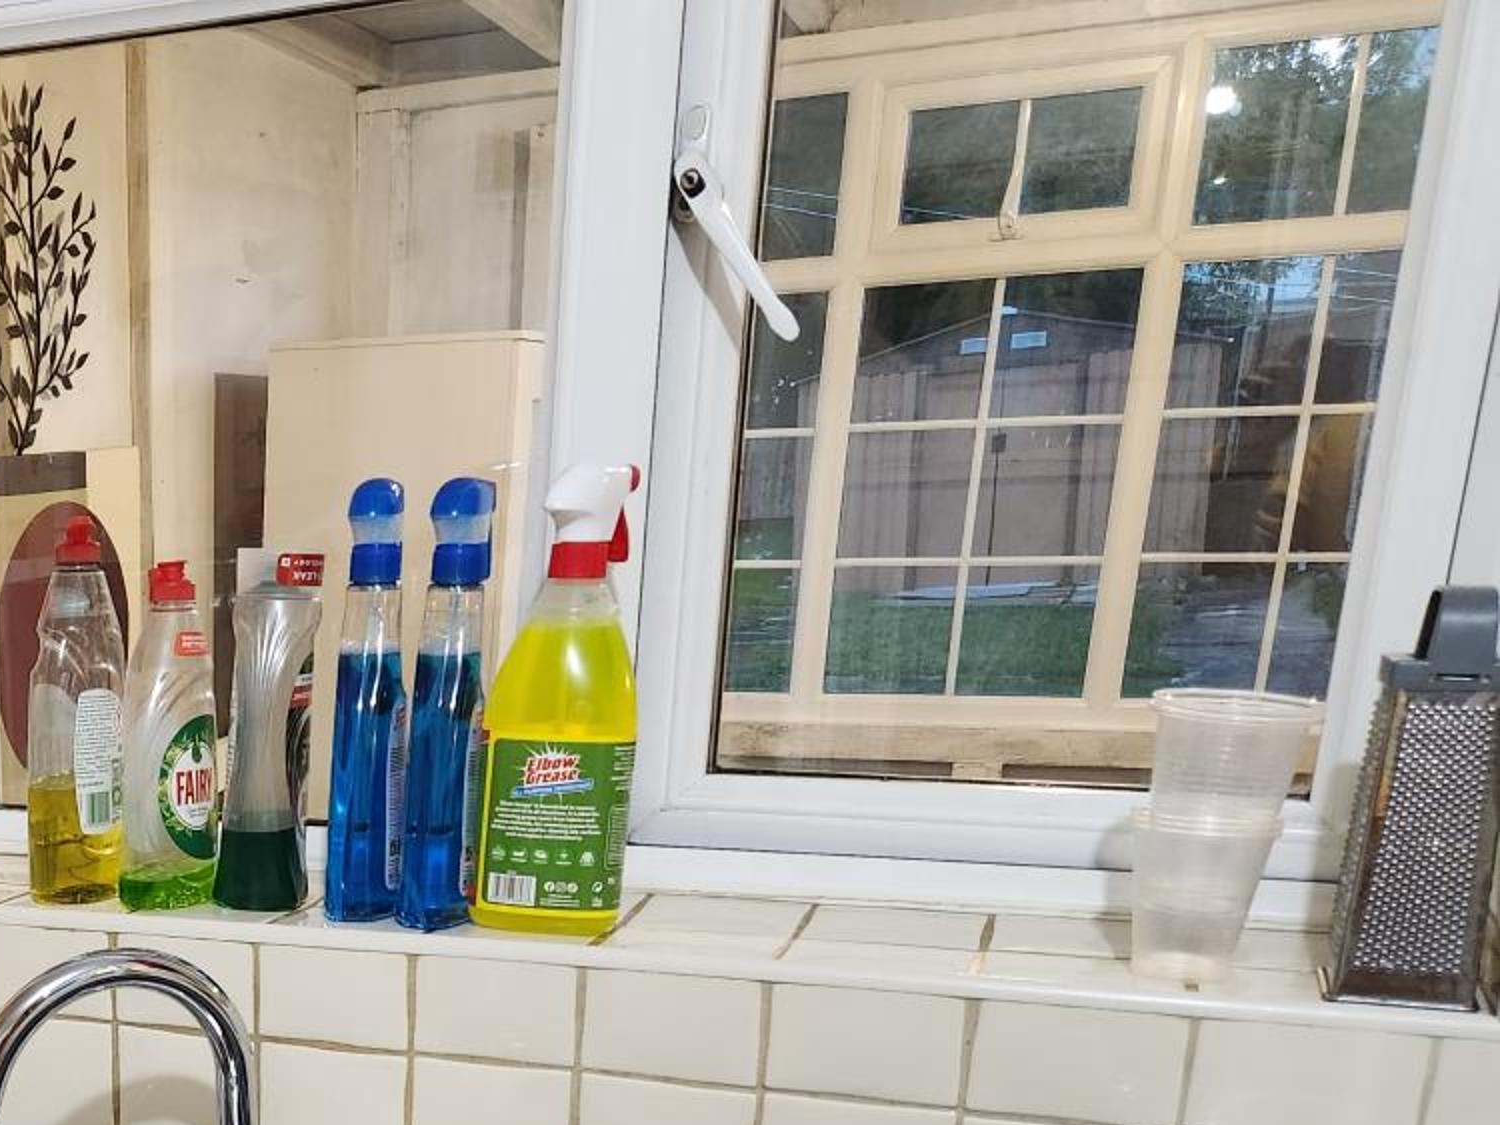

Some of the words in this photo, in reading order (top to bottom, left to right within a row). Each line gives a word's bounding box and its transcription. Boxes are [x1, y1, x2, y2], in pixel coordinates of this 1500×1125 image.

[528, 756, 579, 771] Elbow
[525, 769, 580, 785] Grease
[176, 768, 213, 806] FAIRY
